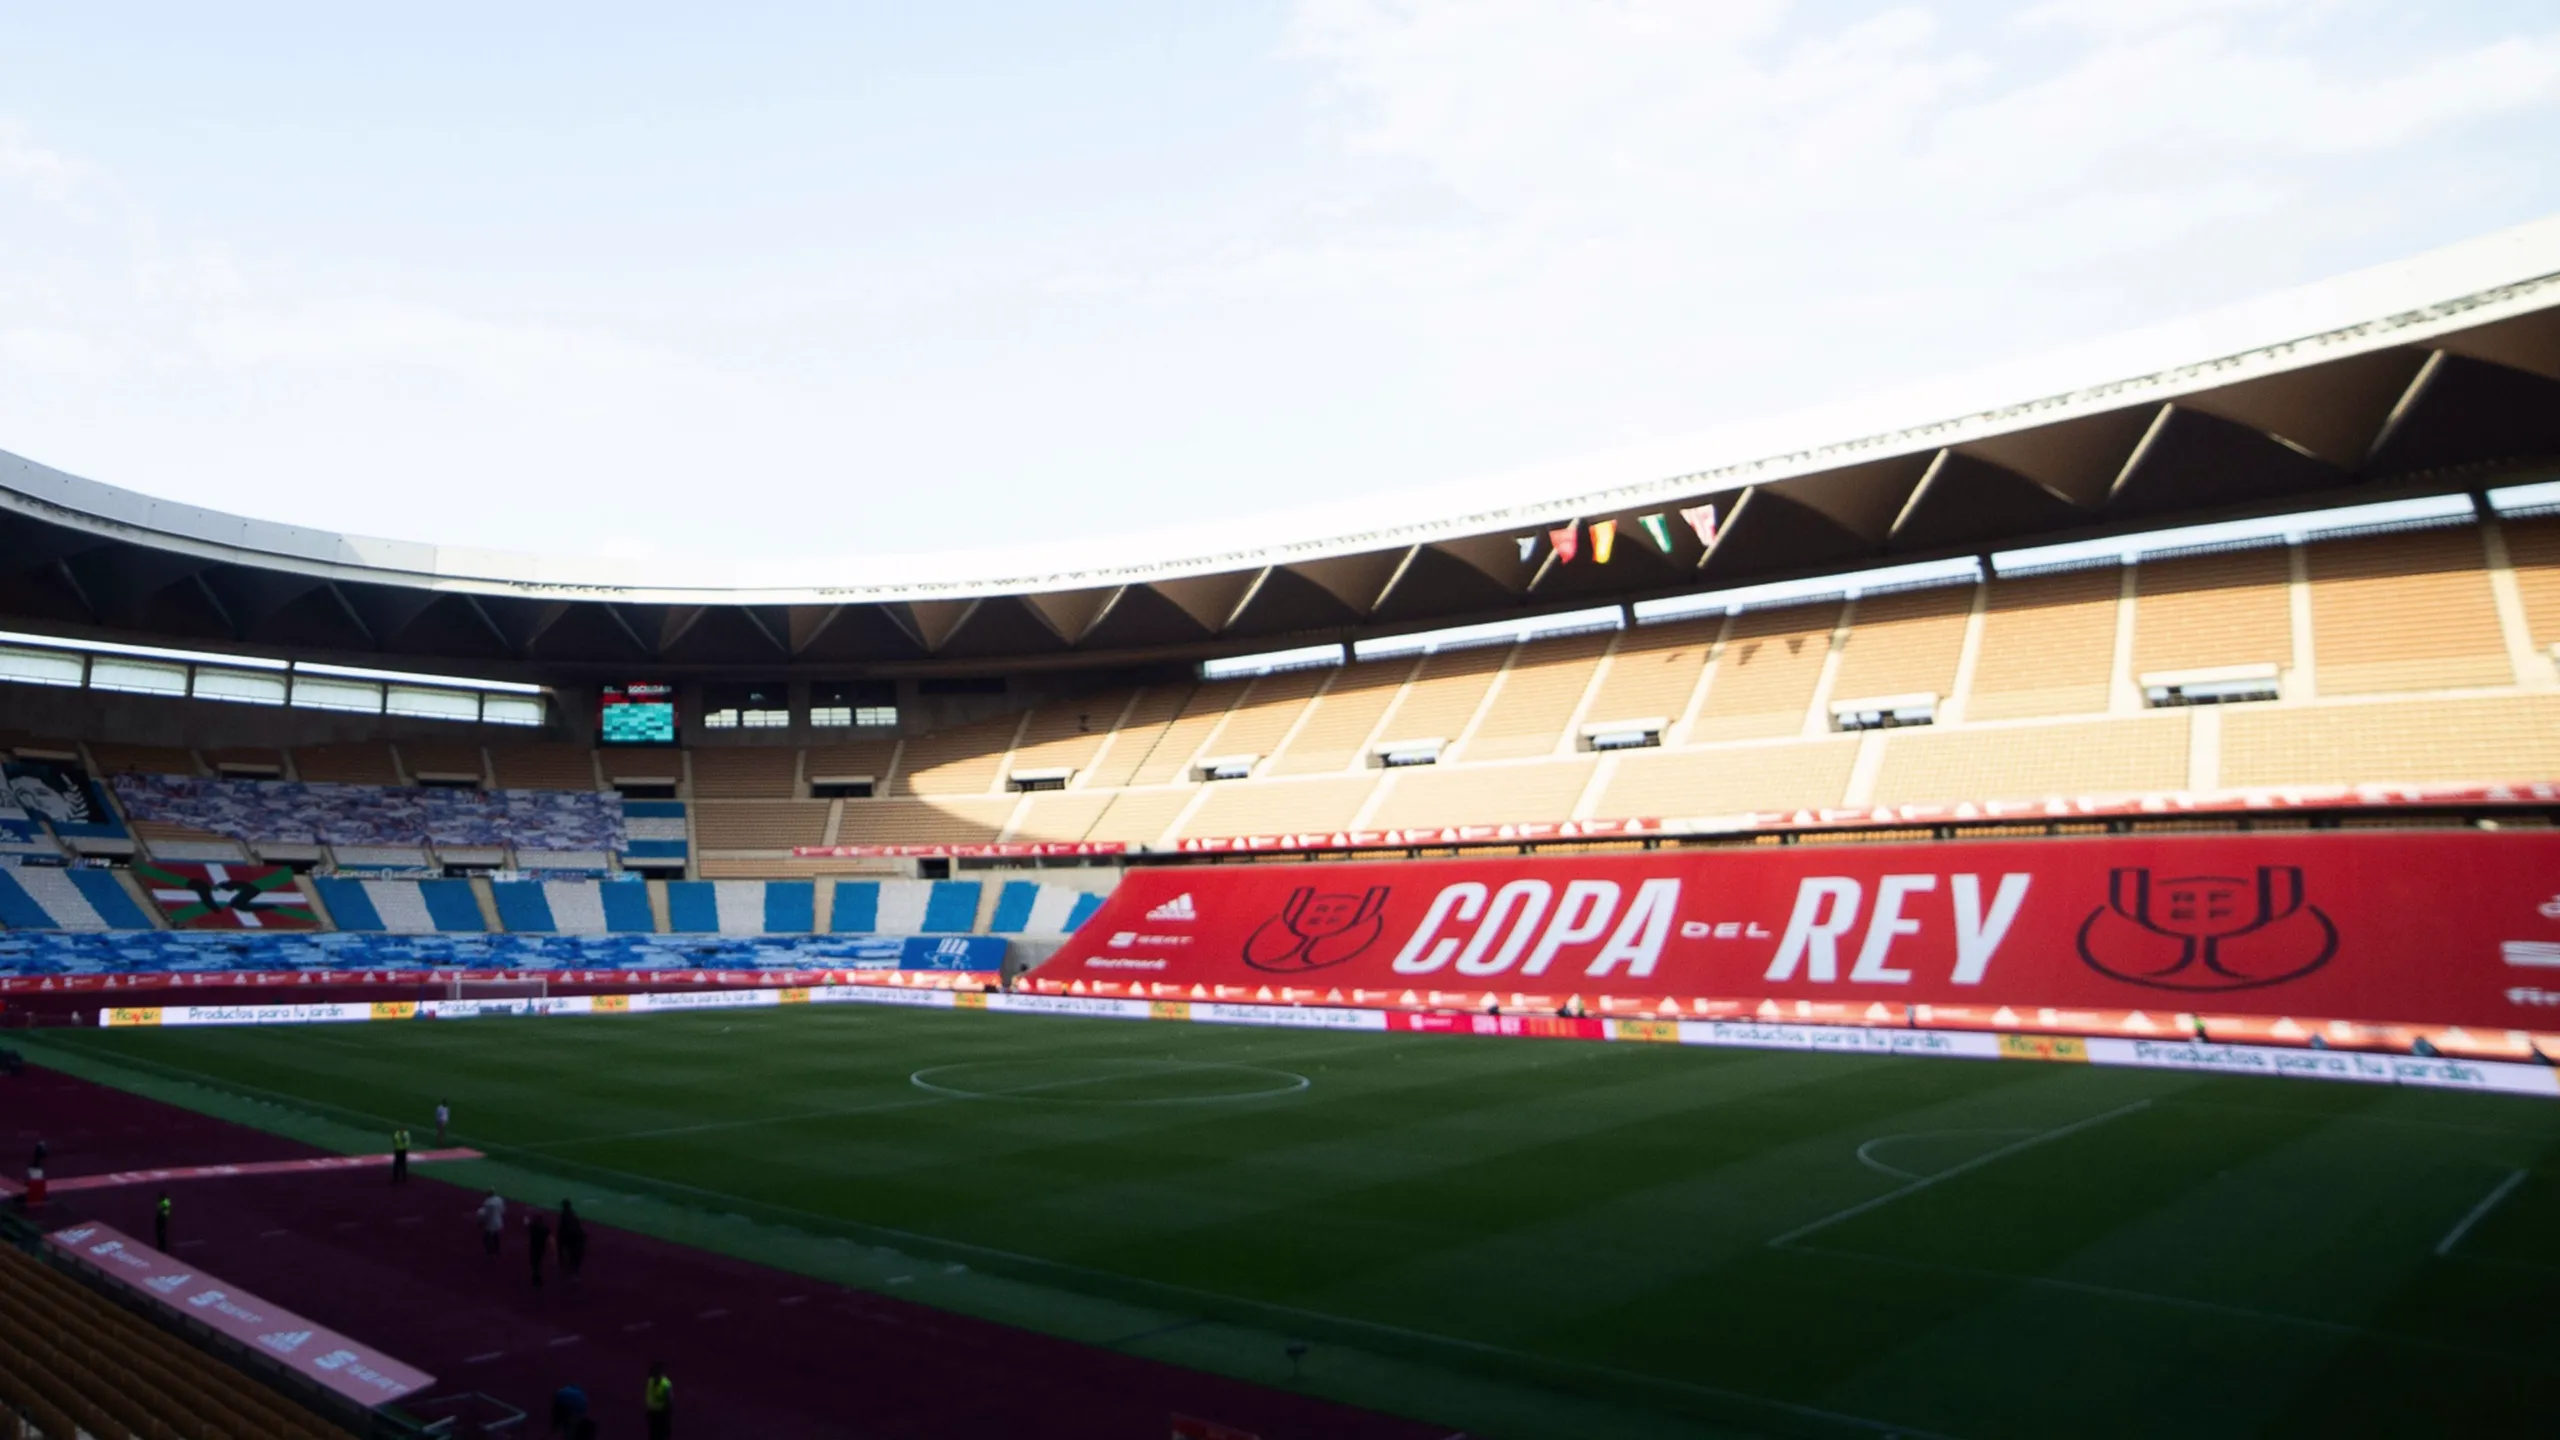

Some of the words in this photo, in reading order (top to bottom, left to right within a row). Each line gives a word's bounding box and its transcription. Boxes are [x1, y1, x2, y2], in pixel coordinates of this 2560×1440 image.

[1391, 877, 1681, 977] COPA
[1680, 921, 1772, 938] DEL
[1763, 872, 2031, 984] REY
[189, 1007, 253, 1020] Productos
[258, 1009, 289, 1022] para
[1713, 1024, 1805, 1043] Productos
[1811, 1028, 1860, 1051] para
[2134, 1041, 2264, 1067] Productos
[2276, 1052, 2347, 1077] para
